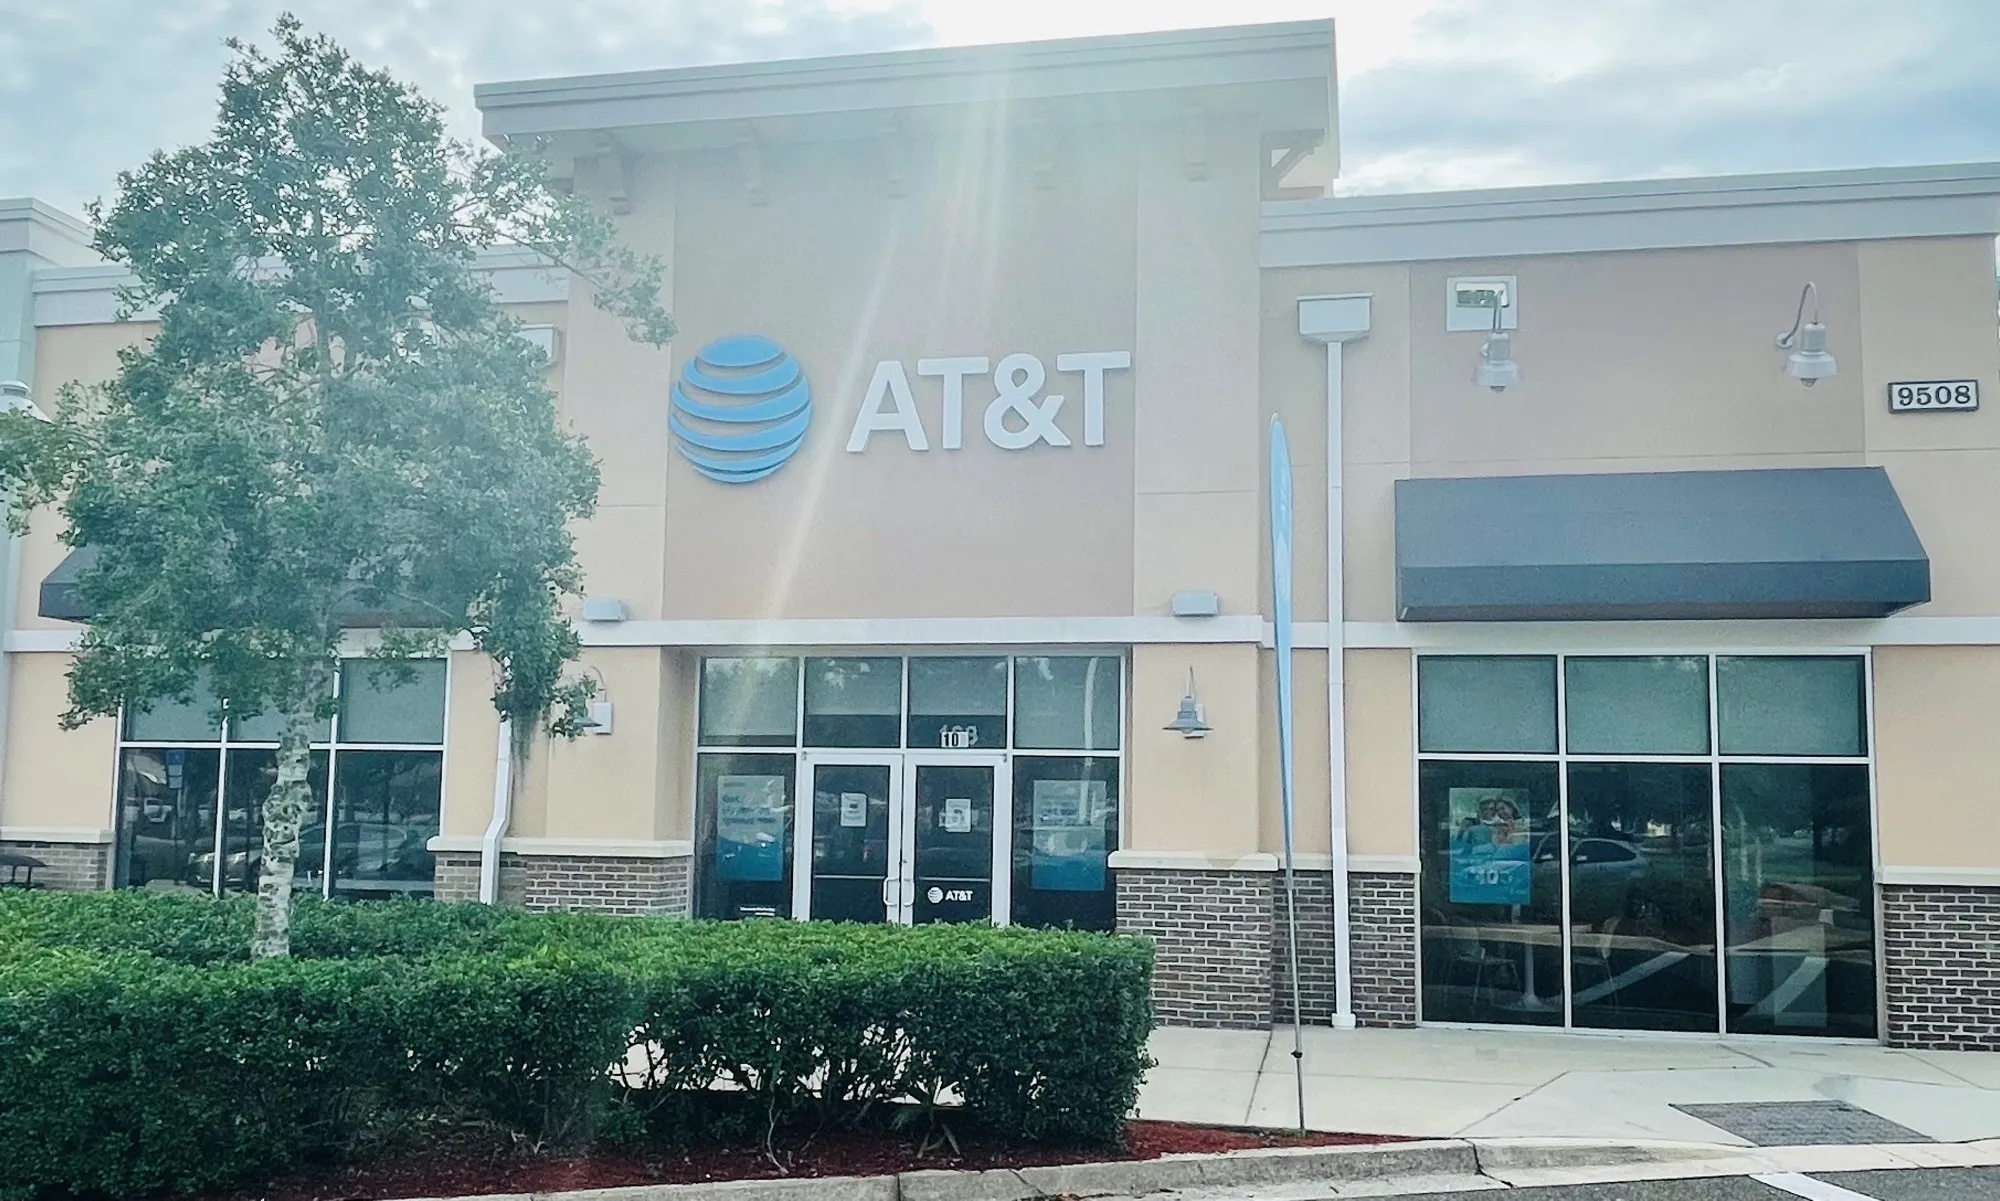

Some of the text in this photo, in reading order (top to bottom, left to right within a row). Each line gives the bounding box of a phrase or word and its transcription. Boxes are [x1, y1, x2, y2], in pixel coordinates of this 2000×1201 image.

[846, 351, 1131, 453] AT&T
[1897, 385, 1971, 407] 9508
[945, 890, 974, 901] AT&T
